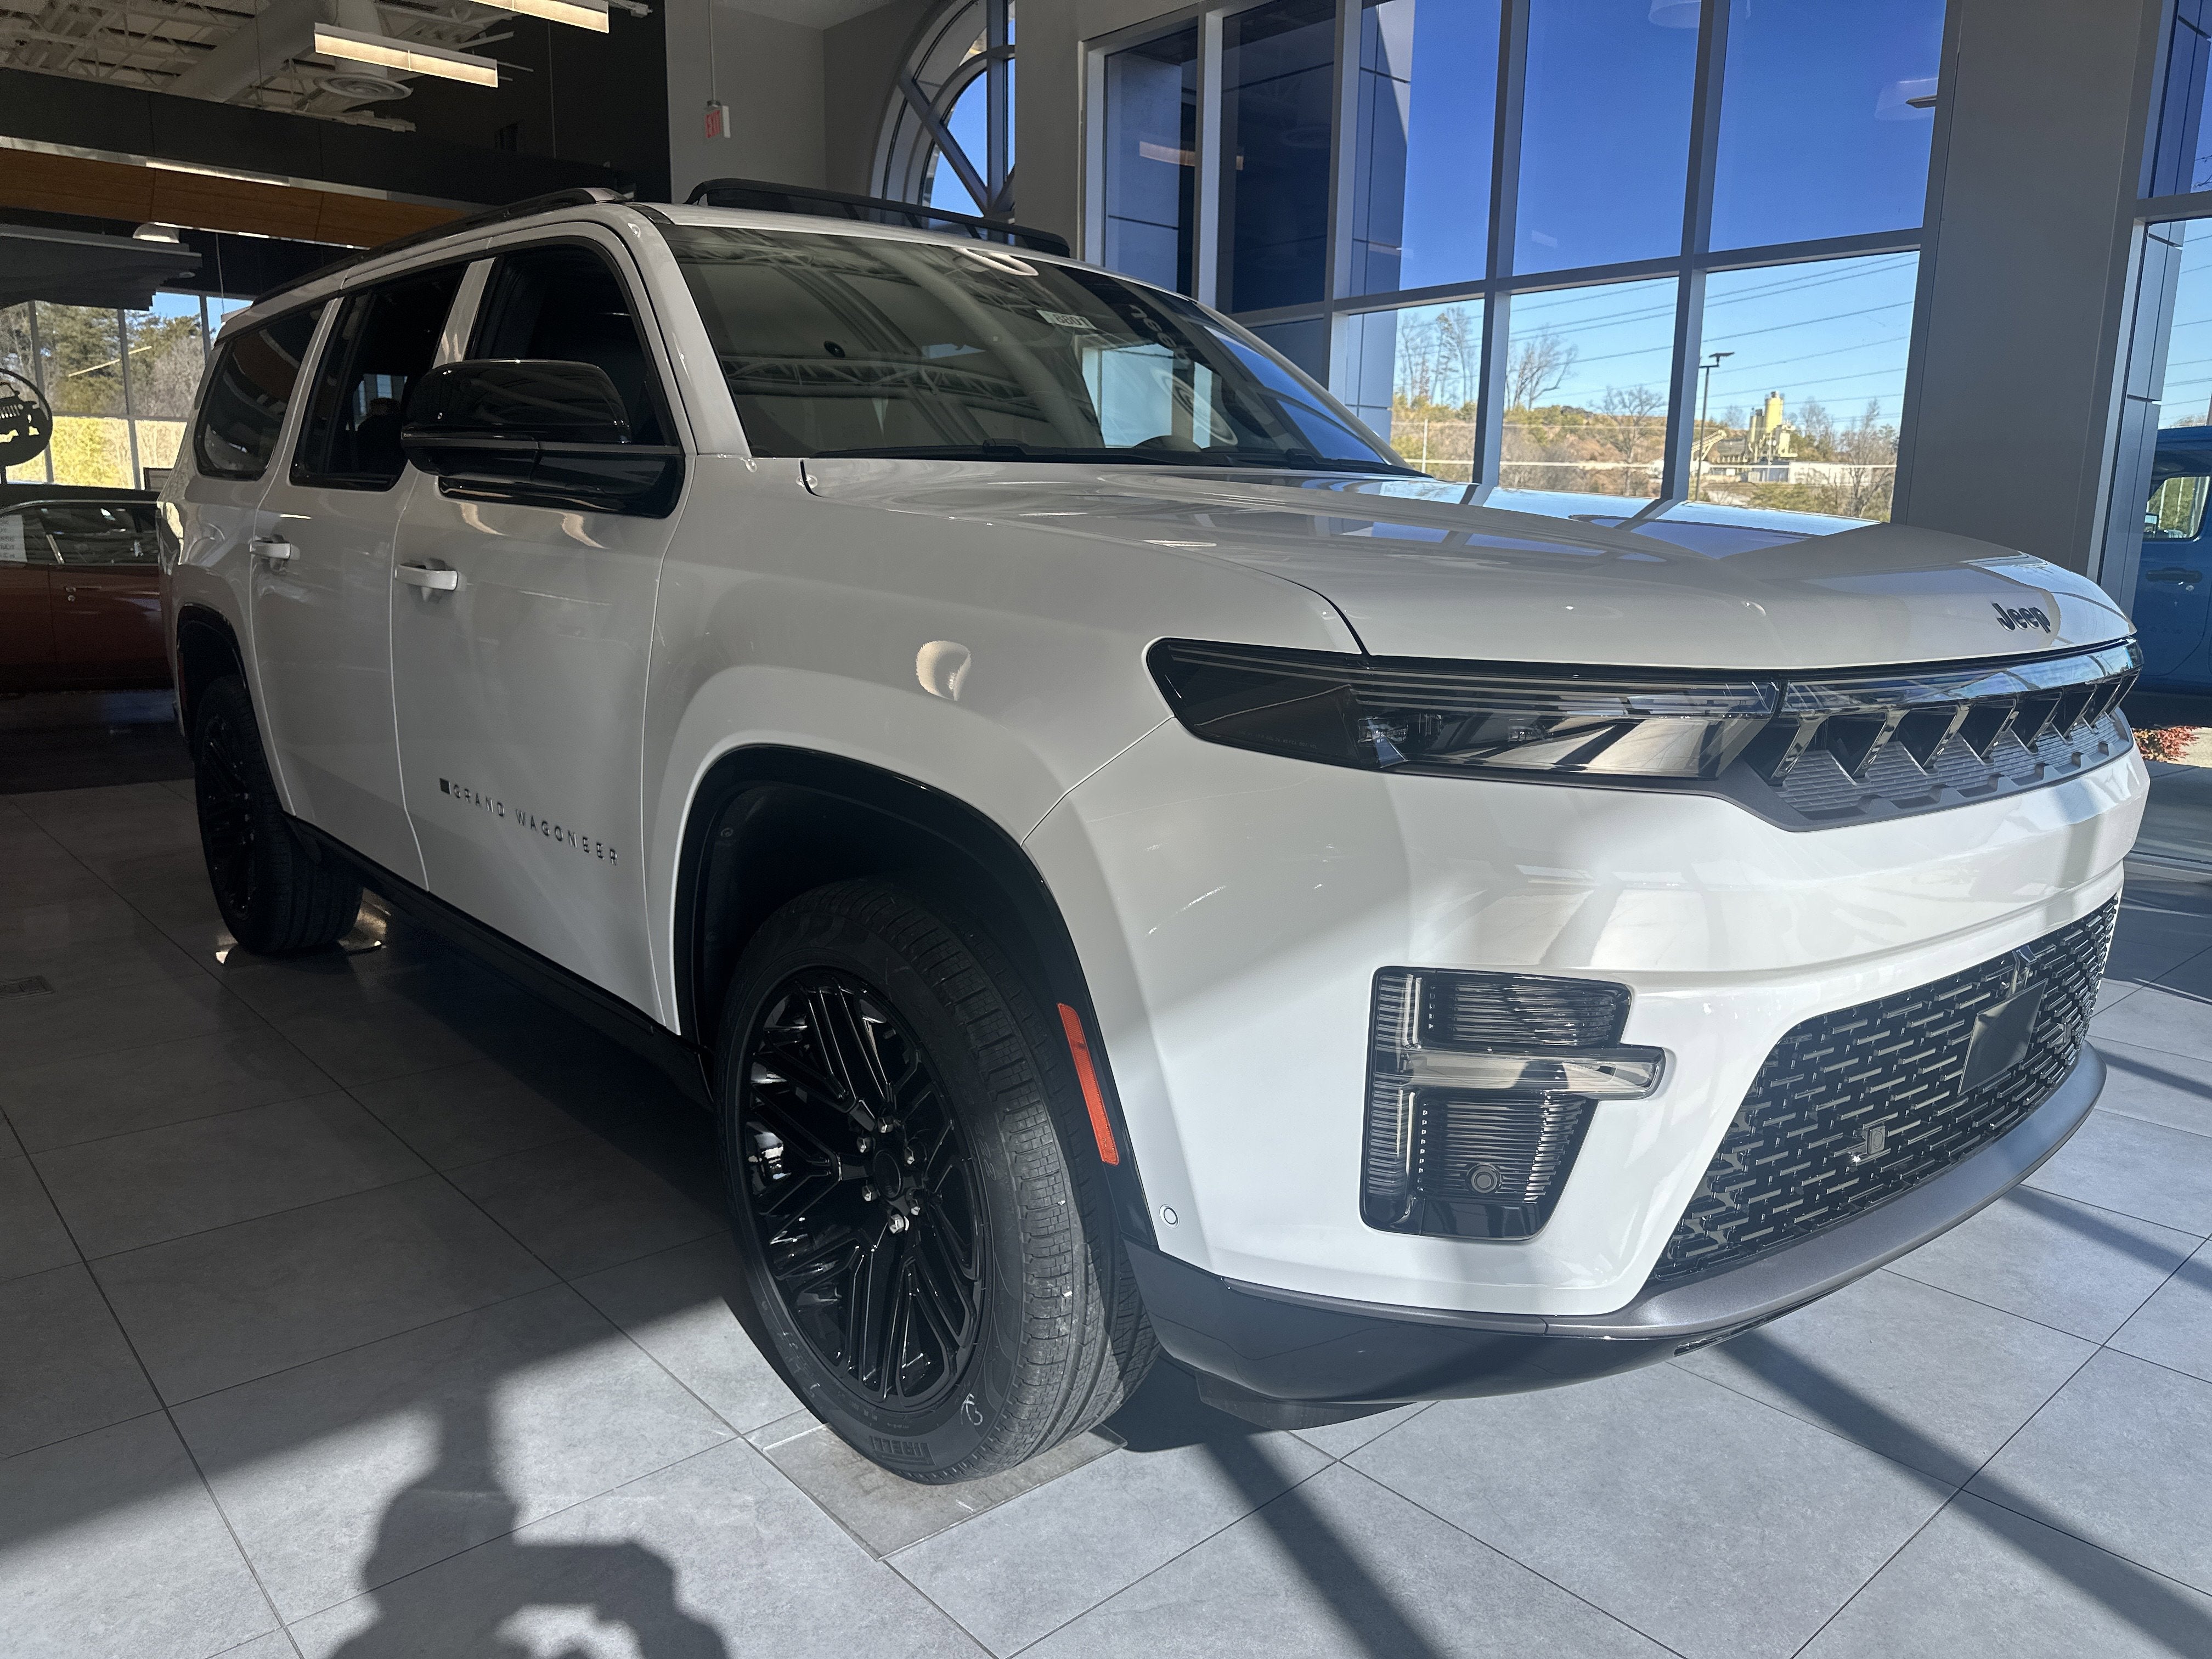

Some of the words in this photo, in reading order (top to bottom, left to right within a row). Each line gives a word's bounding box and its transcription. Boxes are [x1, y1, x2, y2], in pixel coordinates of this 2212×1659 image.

[704, 110, 720, 138] EXIT
[1990, 602, 2051, 634] Jeep
[454, 784, 505, 817] GRAND
[516, 809, 618, 866] WAGONEER
[868, 1435, 936, 1466] PIRELLI
